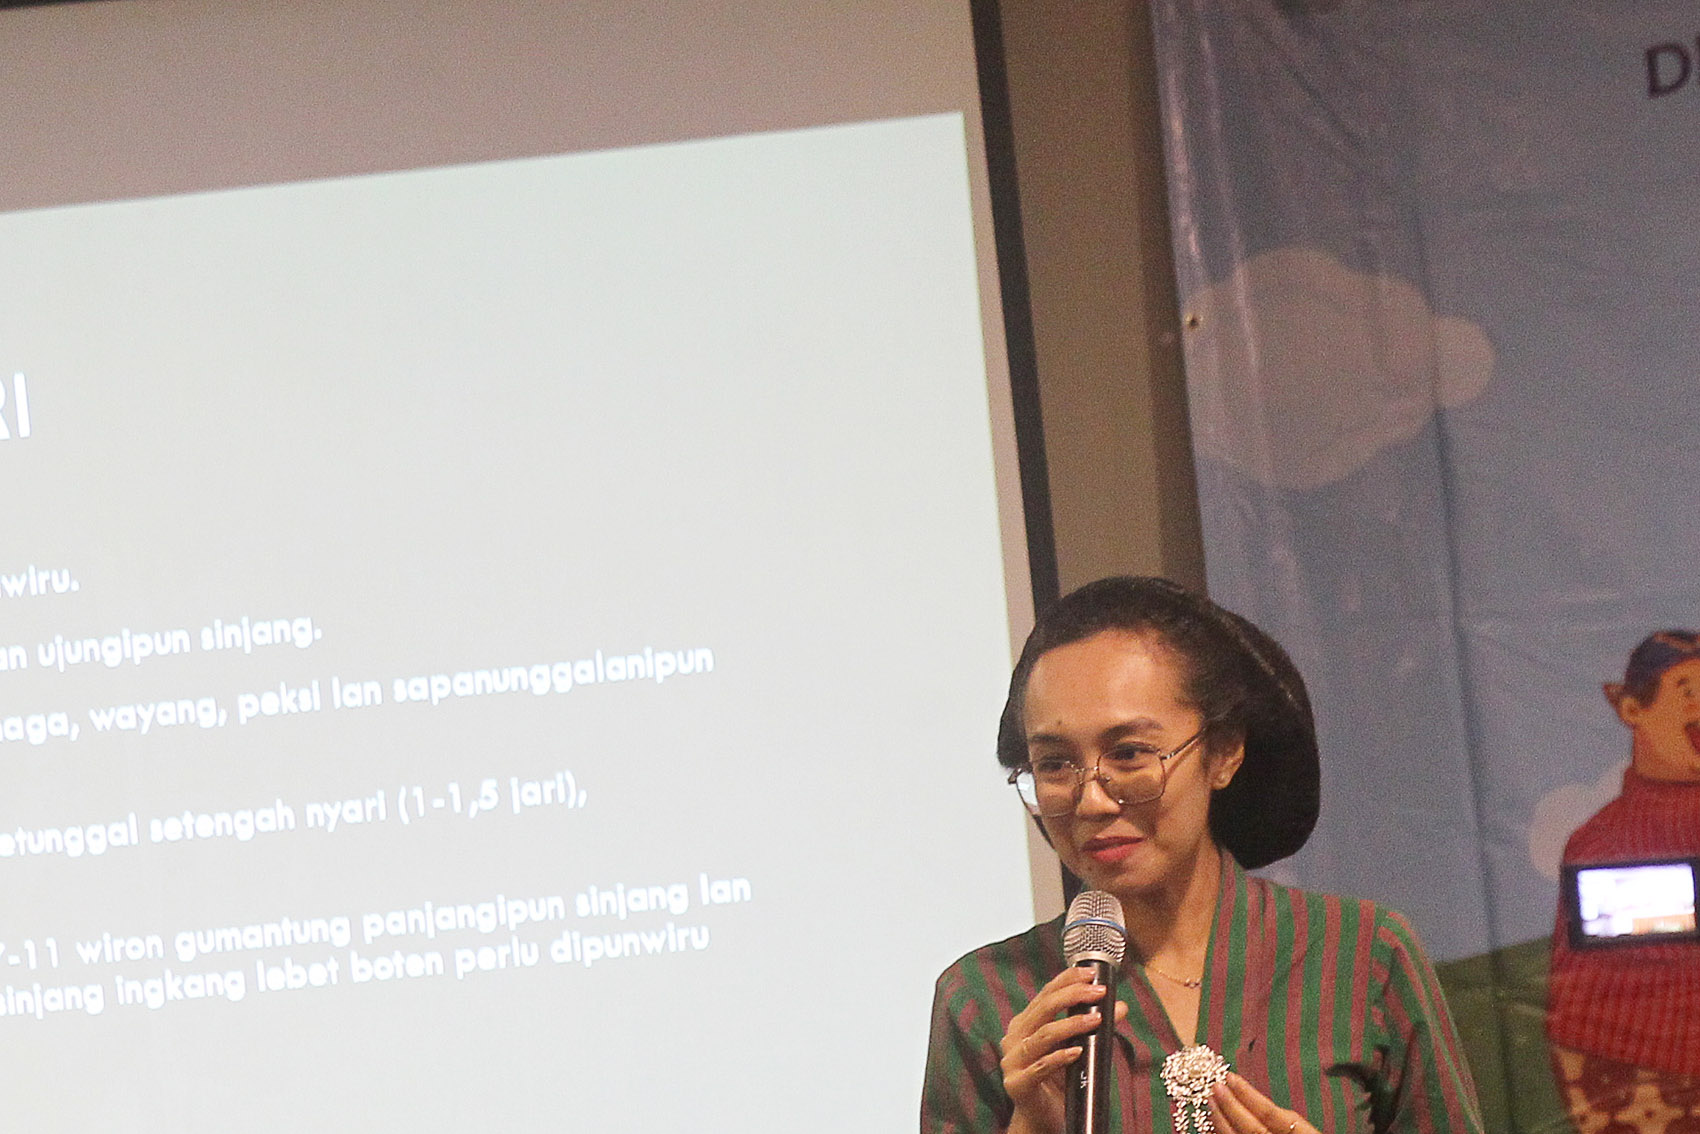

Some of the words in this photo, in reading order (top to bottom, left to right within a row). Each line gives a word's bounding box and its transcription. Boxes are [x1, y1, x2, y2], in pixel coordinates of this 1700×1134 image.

[0, 564, 81, 599] wiru.
[36, 627, 192, 674] ujungipun
[199, 615, 323, 655] sinjang.
[0, 710, 81, 746] aga,
[87, 696, 229, 736] wayang,
[236, 679, 322, 726] peksi
[331, 675, 383, 710] lan
[392, 646, 715, 707] sapanunggalanipun
[149, 797, 297, 844] setengah
[304, 788, 388, 834] nyari
[74, 930, 165, 966] wiron
[173, 915, 352, 963] gumantung
[361, 893, 567, 946] panjangipun
[574, 881, 690, 922] sinjang
[698, 872, 753, 907] lan
[114, 967, 247, 1011] ingkang
[349, 948, 445, 984] boten
[454, 933, 541, 981] perlu
[549, 921, 711, 969] dipunwiru
